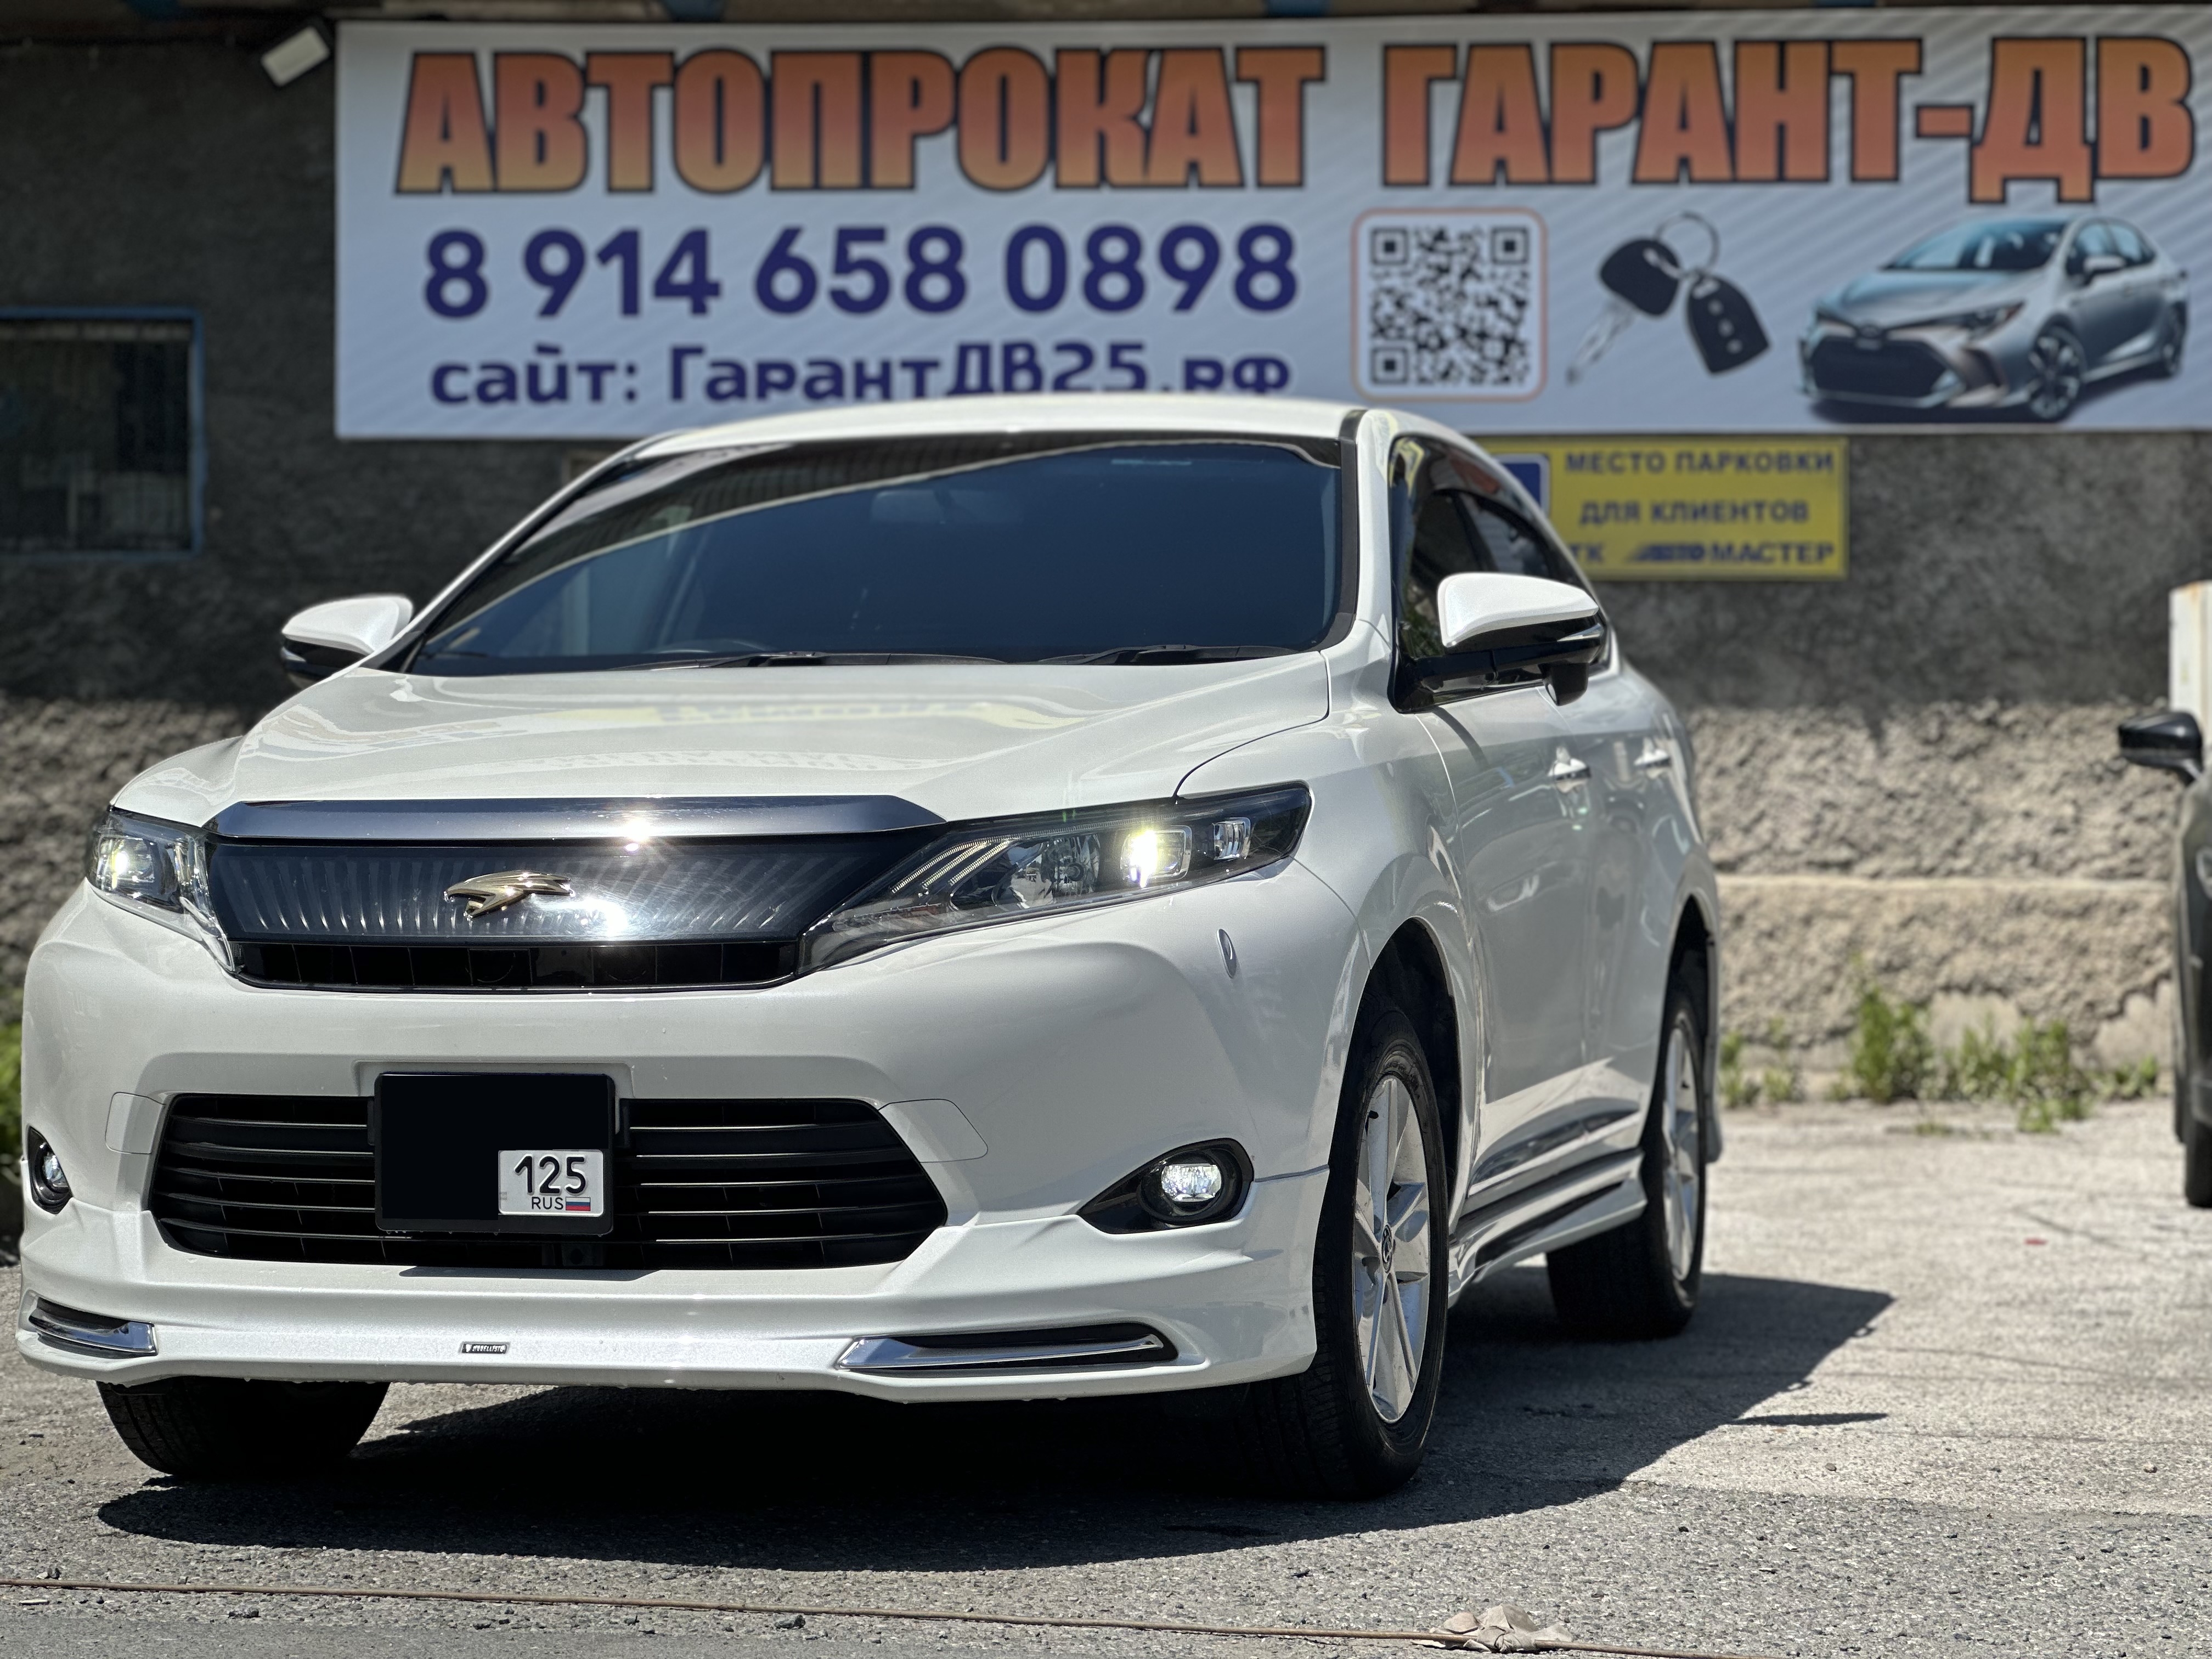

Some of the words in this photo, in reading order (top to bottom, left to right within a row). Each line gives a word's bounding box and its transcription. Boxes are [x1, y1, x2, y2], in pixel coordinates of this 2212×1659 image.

[393, 43, 1327, 195] АВТОПРОКАТ
[1381, 36, 2196, 205] ГАРАНТ-ДВ
[424, 229, 489, 319] 8
[523, 228, 722, 318] 914
[754, 225, 967, 315] 658
[1005, 223, 1298, 314] 0898
[430, 343, 637, 405] сайт:
[1566, 452, 1665, 473] МЕСТО
[1676, 452, 1833, 472] ПАРКОВКИ
[1580, 501, 1640, 526] ДЛЯ
[1650, 500, 1809, 523] КЛИЕНТОВ
[514, 1153, 587, 1195] 125
[531, 1197, 564, 1210] RUS
